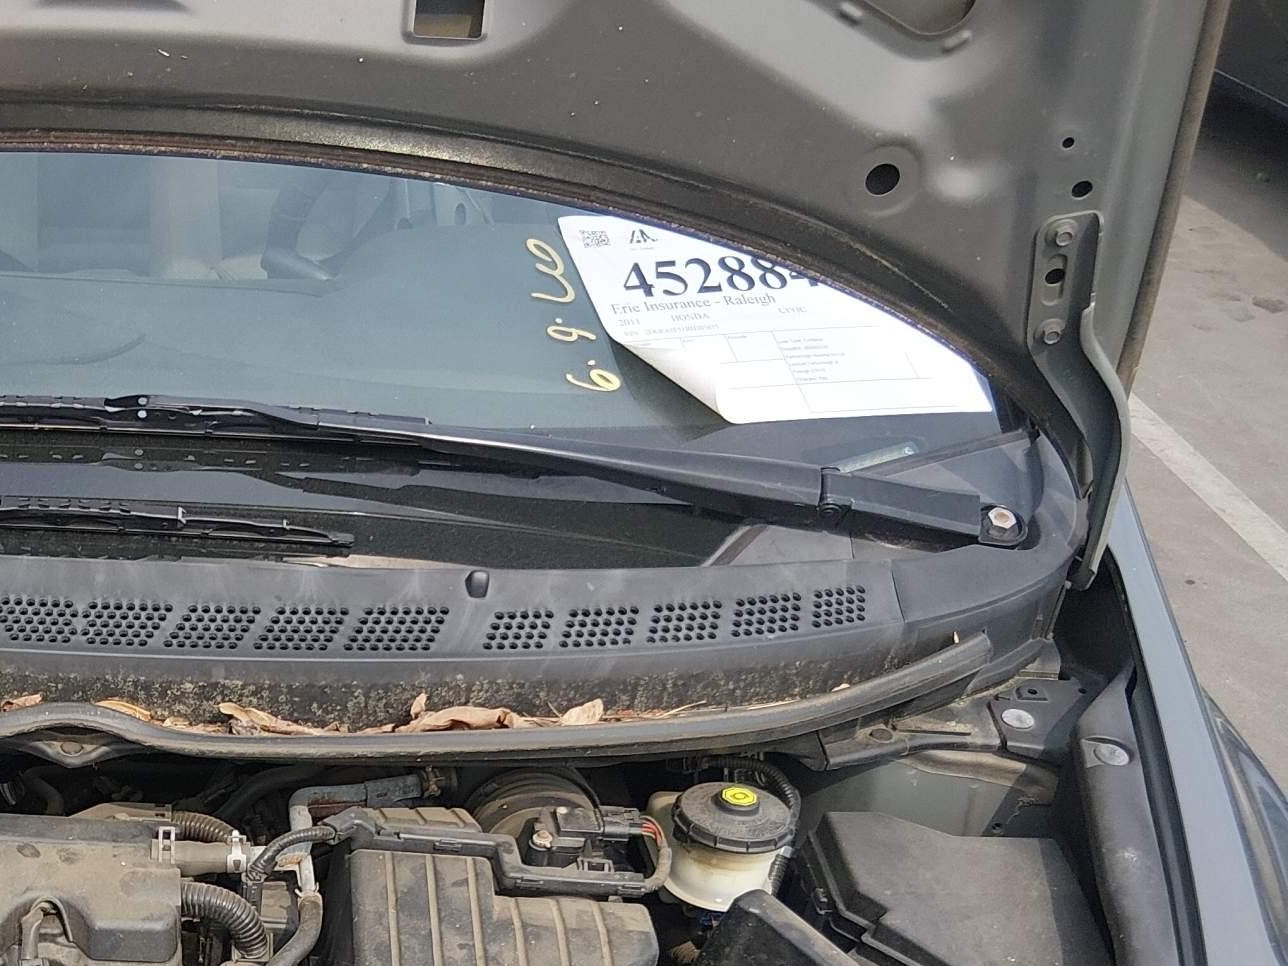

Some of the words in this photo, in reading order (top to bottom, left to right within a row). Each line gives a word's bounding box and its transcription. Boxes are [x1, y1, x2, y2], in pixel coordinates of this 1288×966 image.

[612, 303, 641, 315] Erie
[643, 299, 710, 314] Insurance
[724, 292, 776, 308] Raleigh
